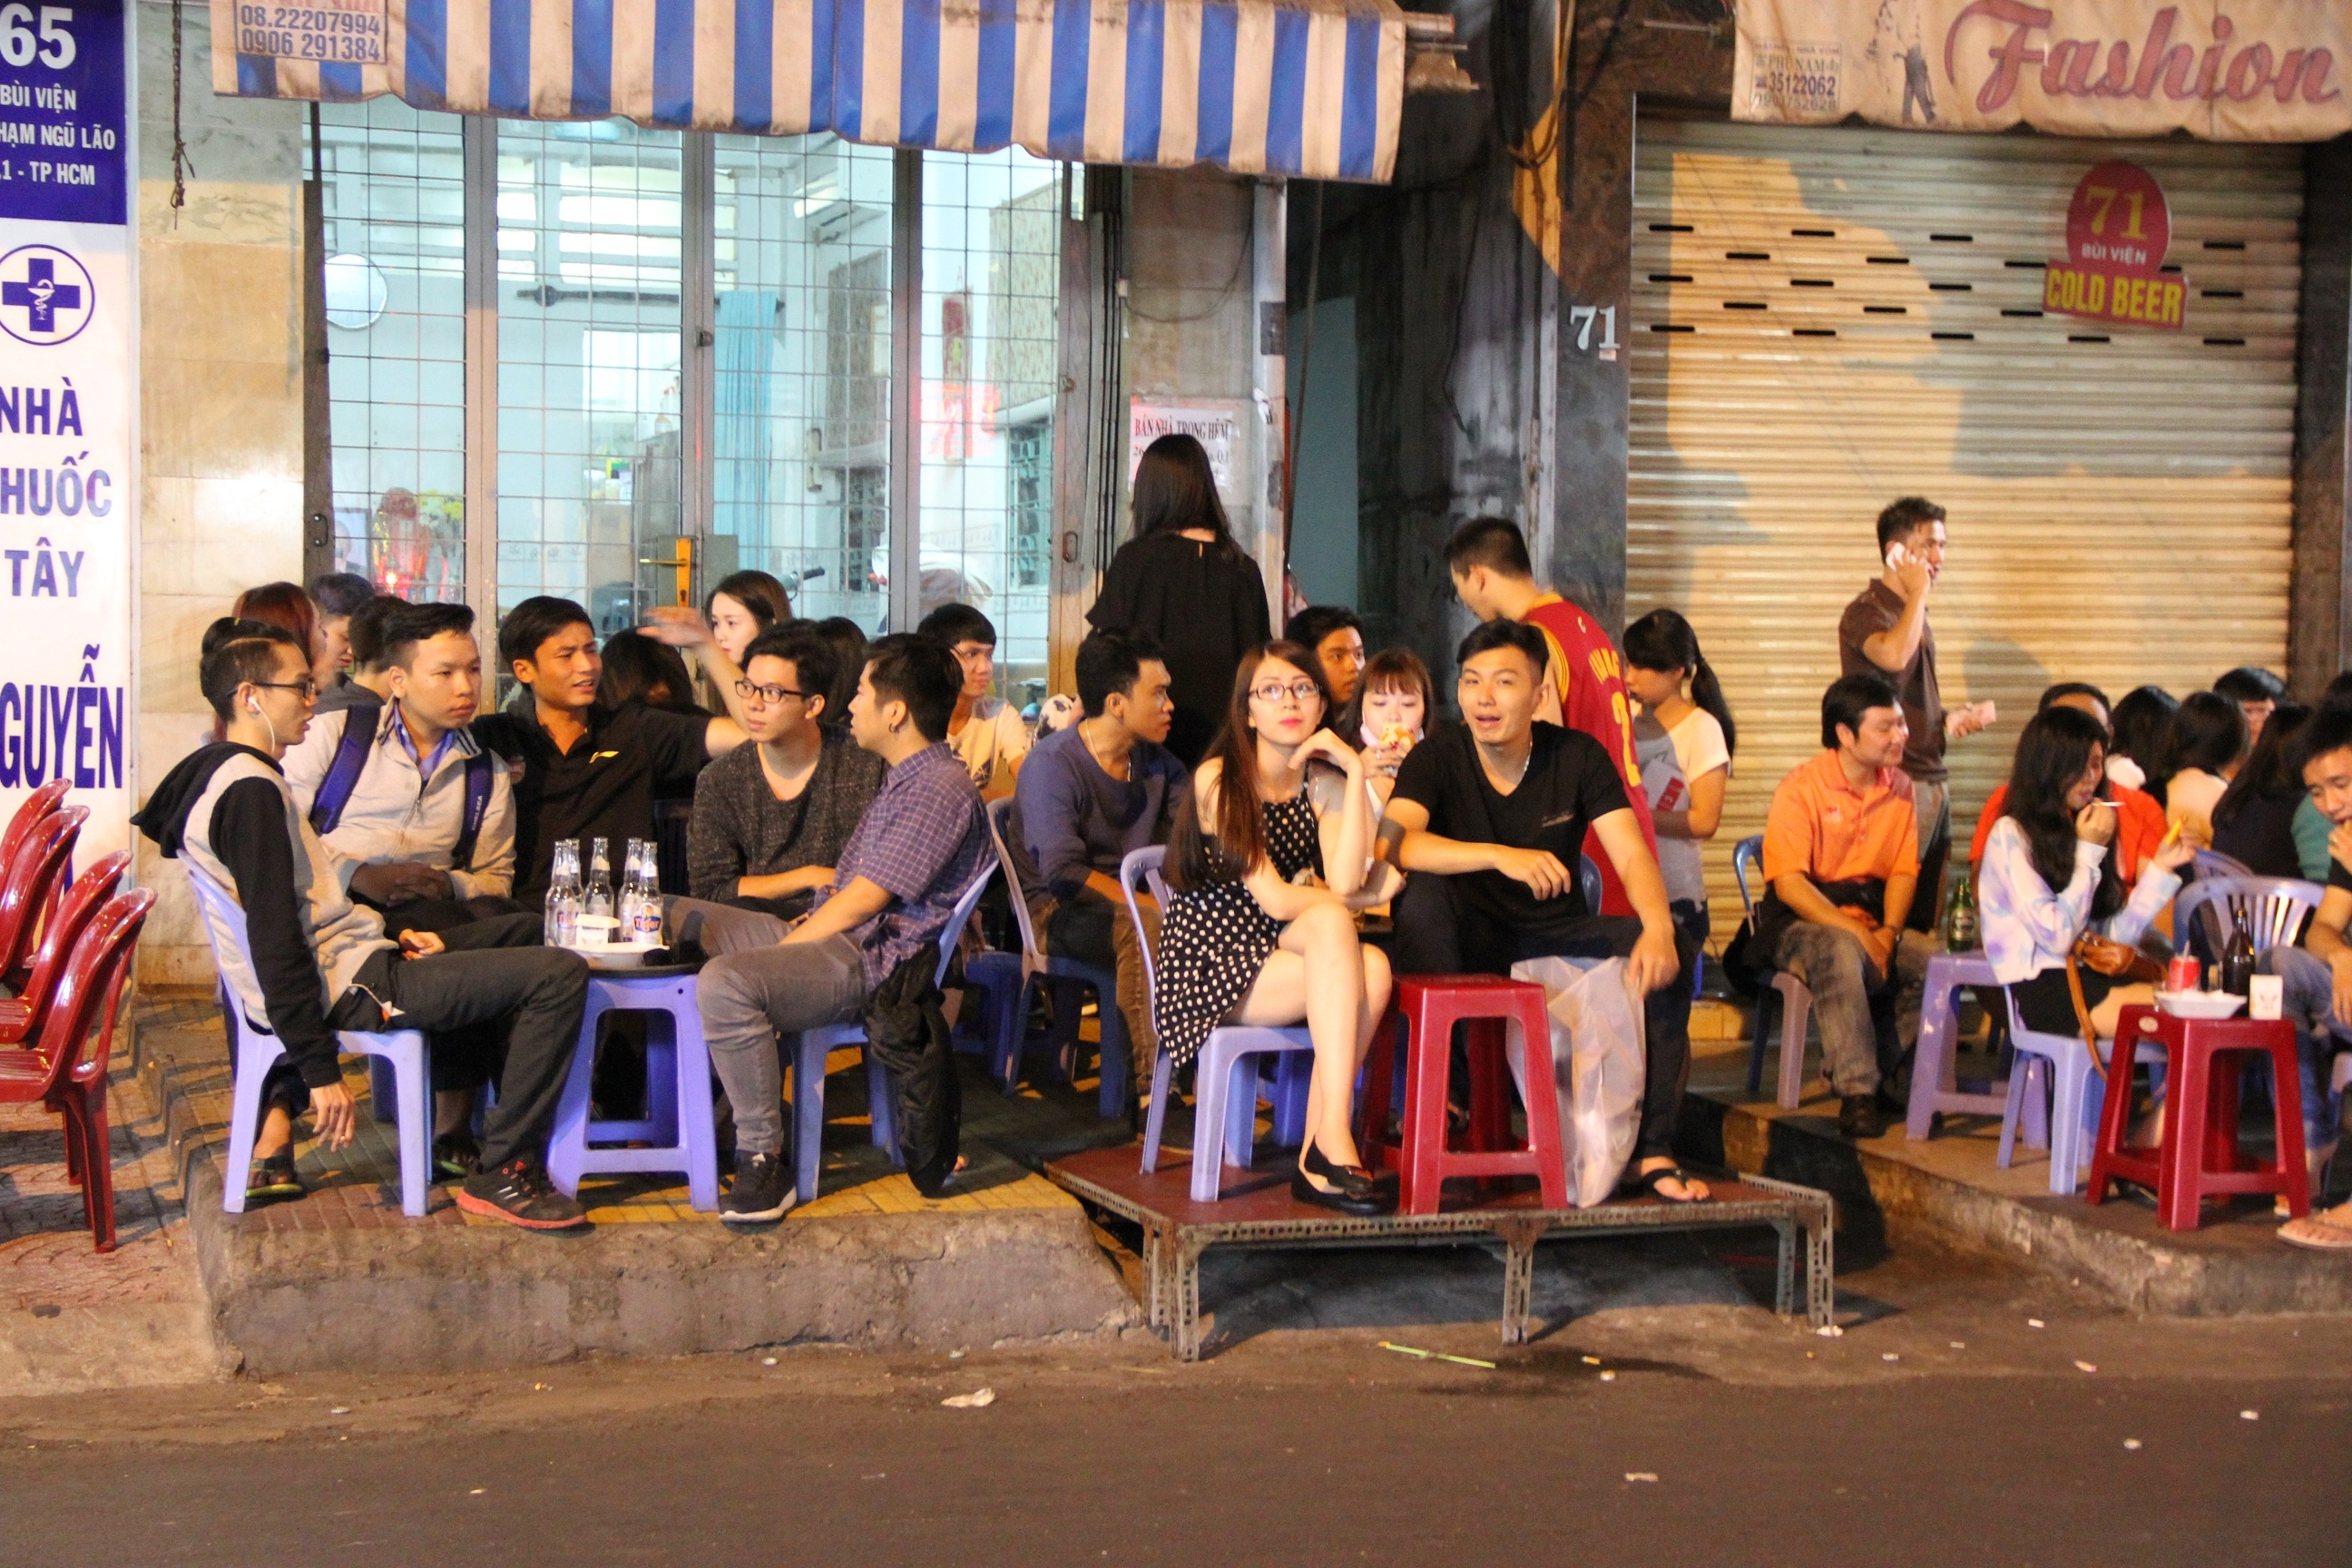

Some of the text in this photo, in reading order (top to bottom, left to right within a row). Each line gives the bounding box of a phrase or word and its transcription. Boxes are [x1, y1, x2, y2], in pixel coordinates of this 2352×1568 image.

[0, 3, 76, 69] 65
[240, 5, 380, 35] 08.22207994
[241, 28, 380, 61] 0906 291384
[1944, 0, 2338, 113] Fashion
[0, 80, 76, 113] BÙI VIỆN
[1769, 71, 1836, 97] 35122062
[41, 121, 75, 148] NGŨ
[81, 123, 116, 150] LÃO
[2087, 185, 2148, 240] 71
[2082, 239, 2147, 265] BÙI VIỆN
[2046, 269, 2182, 324] COLD BEER
[1570, 305, 1621, 350] 71
[0, 377, 83, 436] NHÀ
[1135, 414, 1153, 436] BÁN
[0, 451, 112, 517] HUỐC
[4, 536, 84, 597] TÂY
[0, 643, 122, 789] GUYỄN
